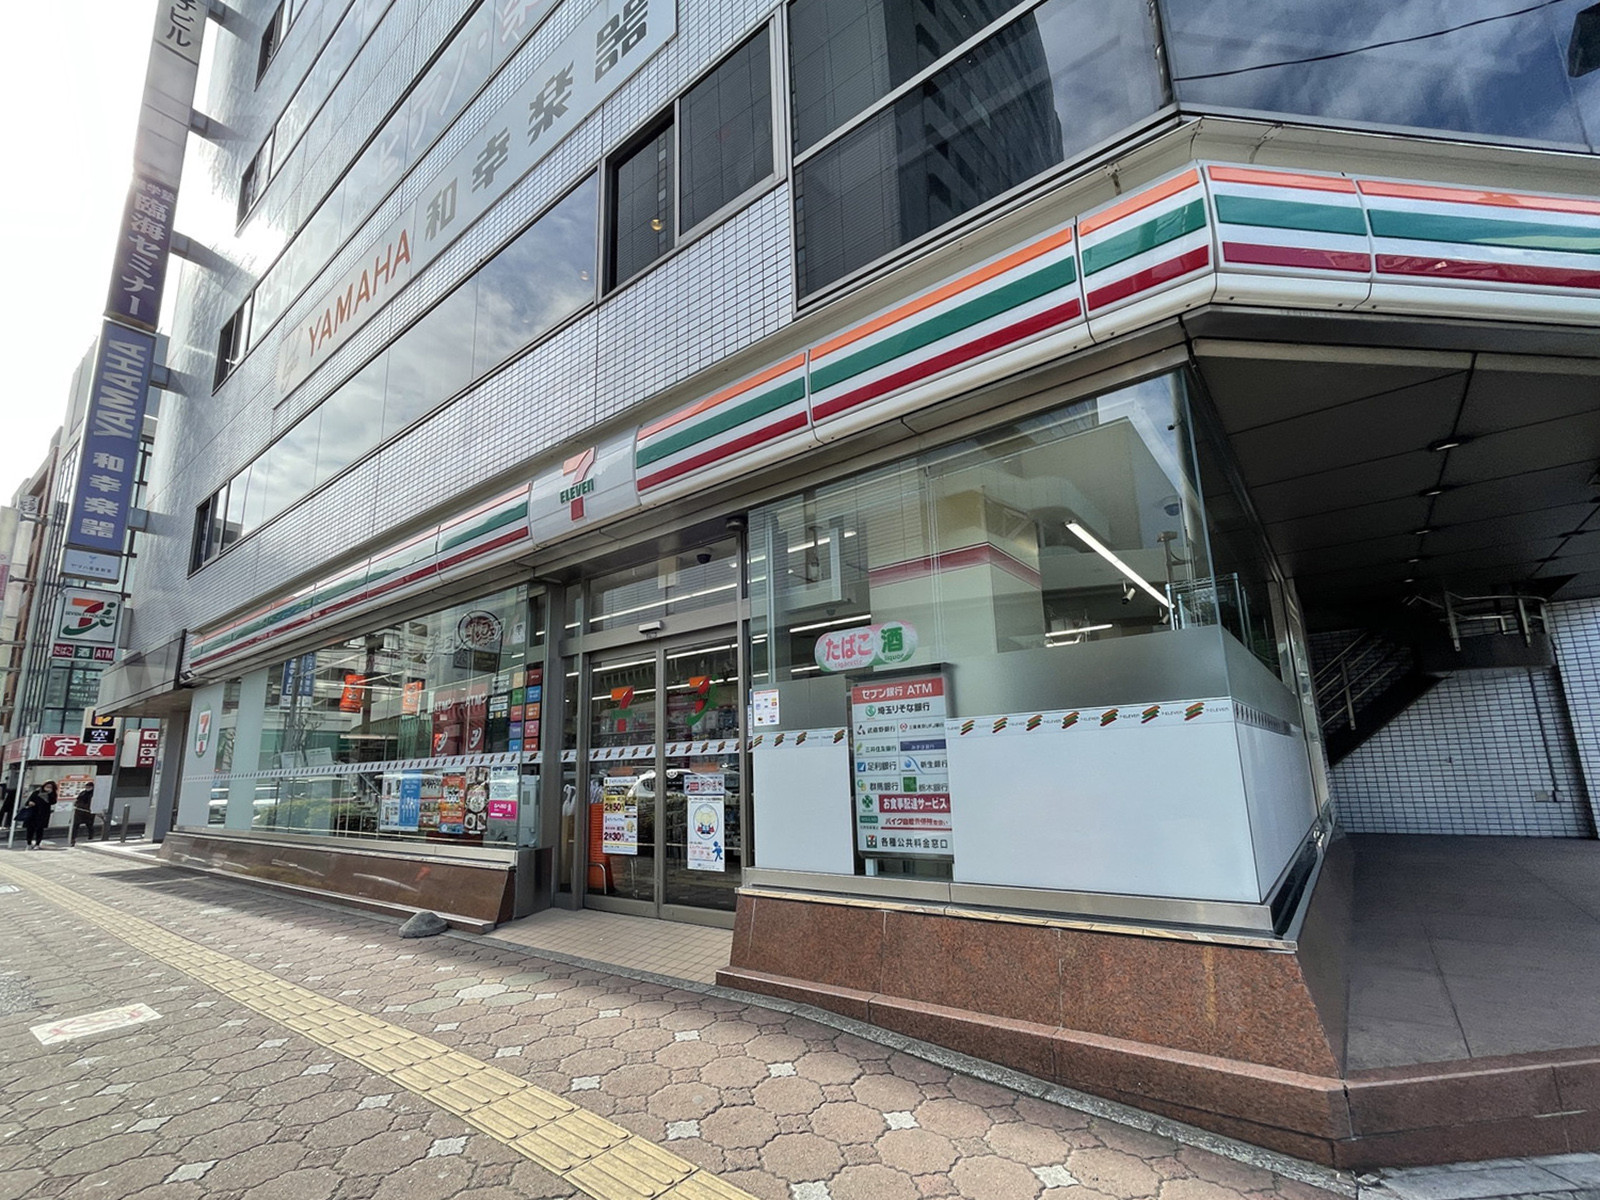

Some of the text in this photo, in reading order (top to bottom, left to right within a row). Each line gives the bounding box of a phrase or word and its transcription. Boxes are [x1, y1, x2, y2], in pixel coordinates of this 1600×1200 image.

[307, 229, 411, 358] YAMAHA
[93, 339, 147, 439] YAMAHA
[80, 452, 125, 539] 和幸楽器
[825, 626, 903, 661] たばこ 酒
[95, 649, 113, 659] ATM
[862, 683, 932, 699] セブン銀行 ATM
[877, 702, 930, 715] 埼玉りそな銀行
[867, 761, 897, 771] 足利銀行
[920, 760, 947, 768] 新生銀行
[869, 782, 899, 791] 群馬銀行
[919, 783, 948, 792] 栃木銀行
[883, 797, 947, 810] お食事配達サービス
[881, 837, 948, 849] 各種公共料金窓口
